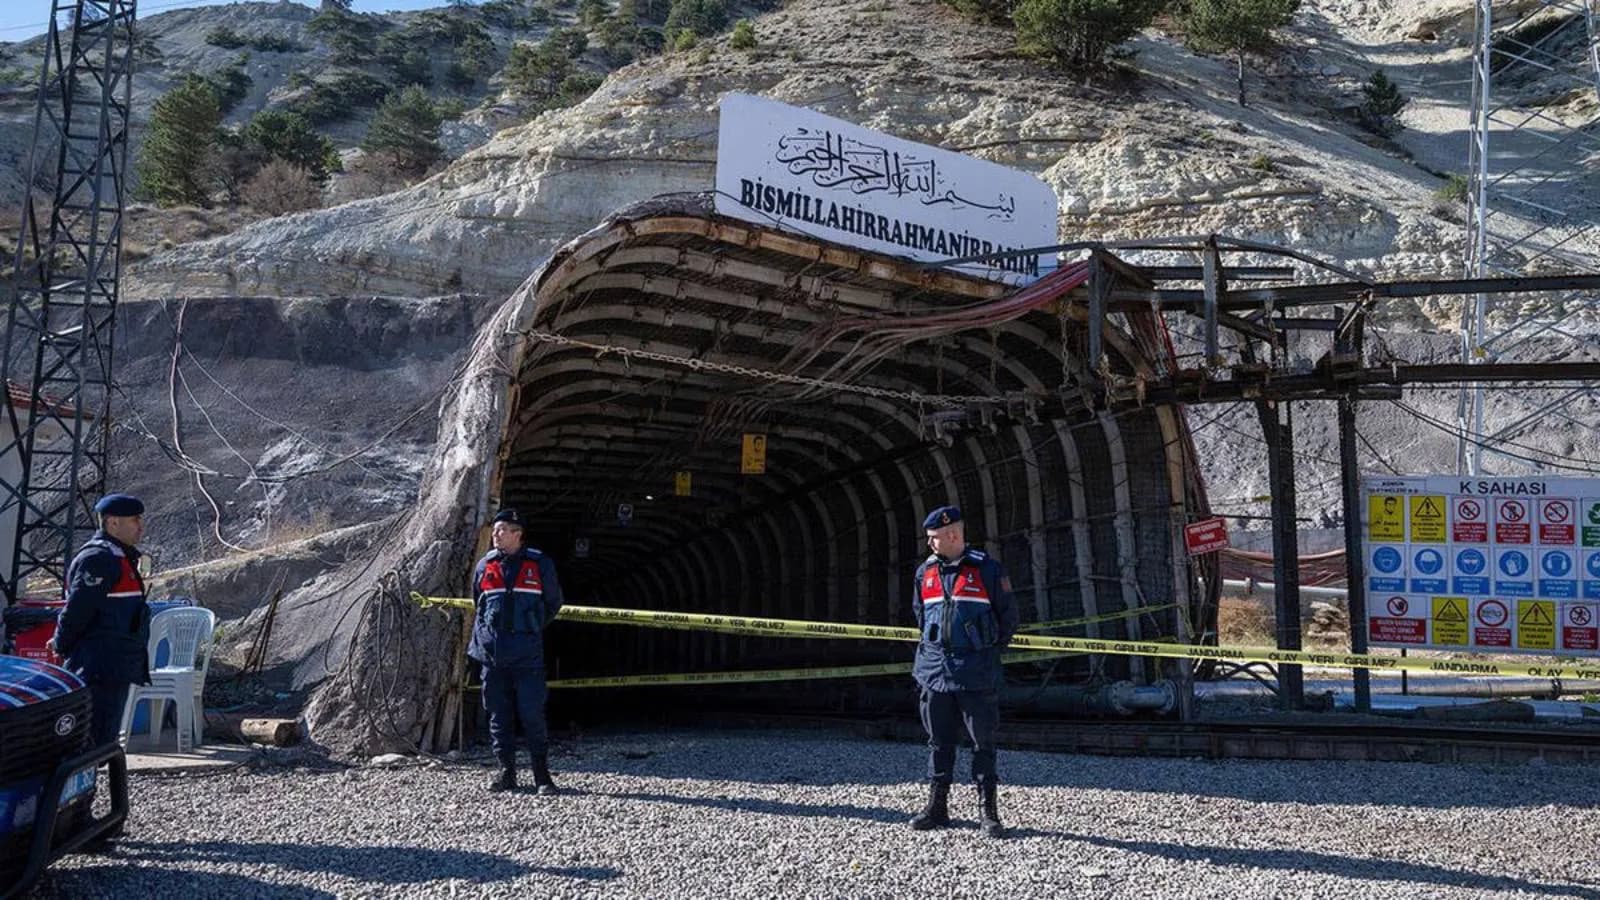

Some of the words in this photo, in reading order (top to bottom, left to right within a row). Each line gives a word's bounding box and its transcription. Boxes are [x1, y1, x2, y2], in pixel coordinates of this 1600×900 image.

[1459, 481, 1473, 494] K
[1477, 480, 1547, 496] SAHASI
[703, 616, 723, 625] OLAY
[805, 624, 849, 635] JANDARMA
[864, 627, 887, 637] OLAY
[1050, 639, 1076, 649] OLAY
[1186, 647, 1245, 659] JANDARMA
[1267, 652, 1299, 662] OLAY
[1430, 661, 1499, 674] JANDARMA
[1527, 667, 1564, 677] OLAY
[1575, 669, 1600, 679] YER
